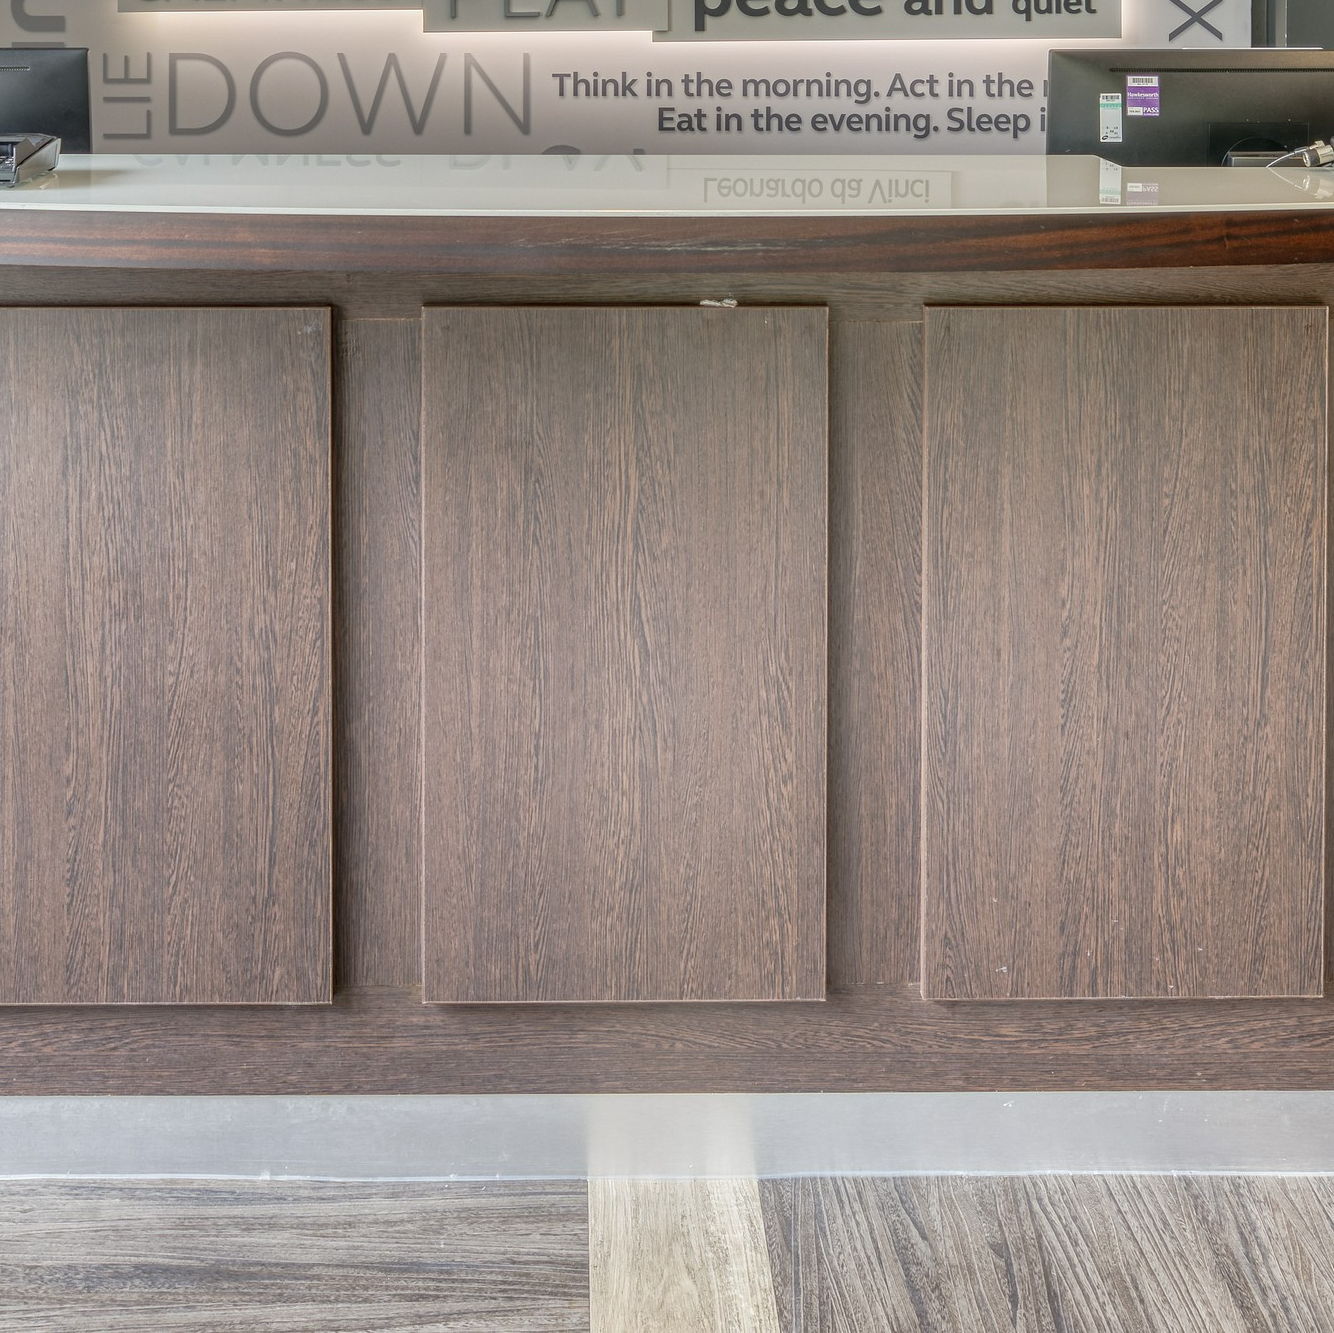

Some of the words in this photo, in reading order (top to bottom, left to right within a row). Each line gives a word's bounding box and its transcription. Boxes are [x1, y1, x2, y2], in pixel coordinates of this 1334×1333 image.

[102, 51, 152, 140] LIE
[168, 51, 532, 137] DOWN
[552, 72, 638, 98] Think
[647, 72, 673, 97] in
[681, 72, 733, 98] the
[743, 72, 880, 105] morning.
[886, 73, 939, 97] Act
[948, 72, 974, 97] in
[983, 72, 1034, 97] the
[658, 108, 707, 132] Eat
[716, 107, 742, 132] in
[751, 107, 802, 132] the
[811, 107, 939, 139] evening.
[947, 107, 1030, 139] Sleep
